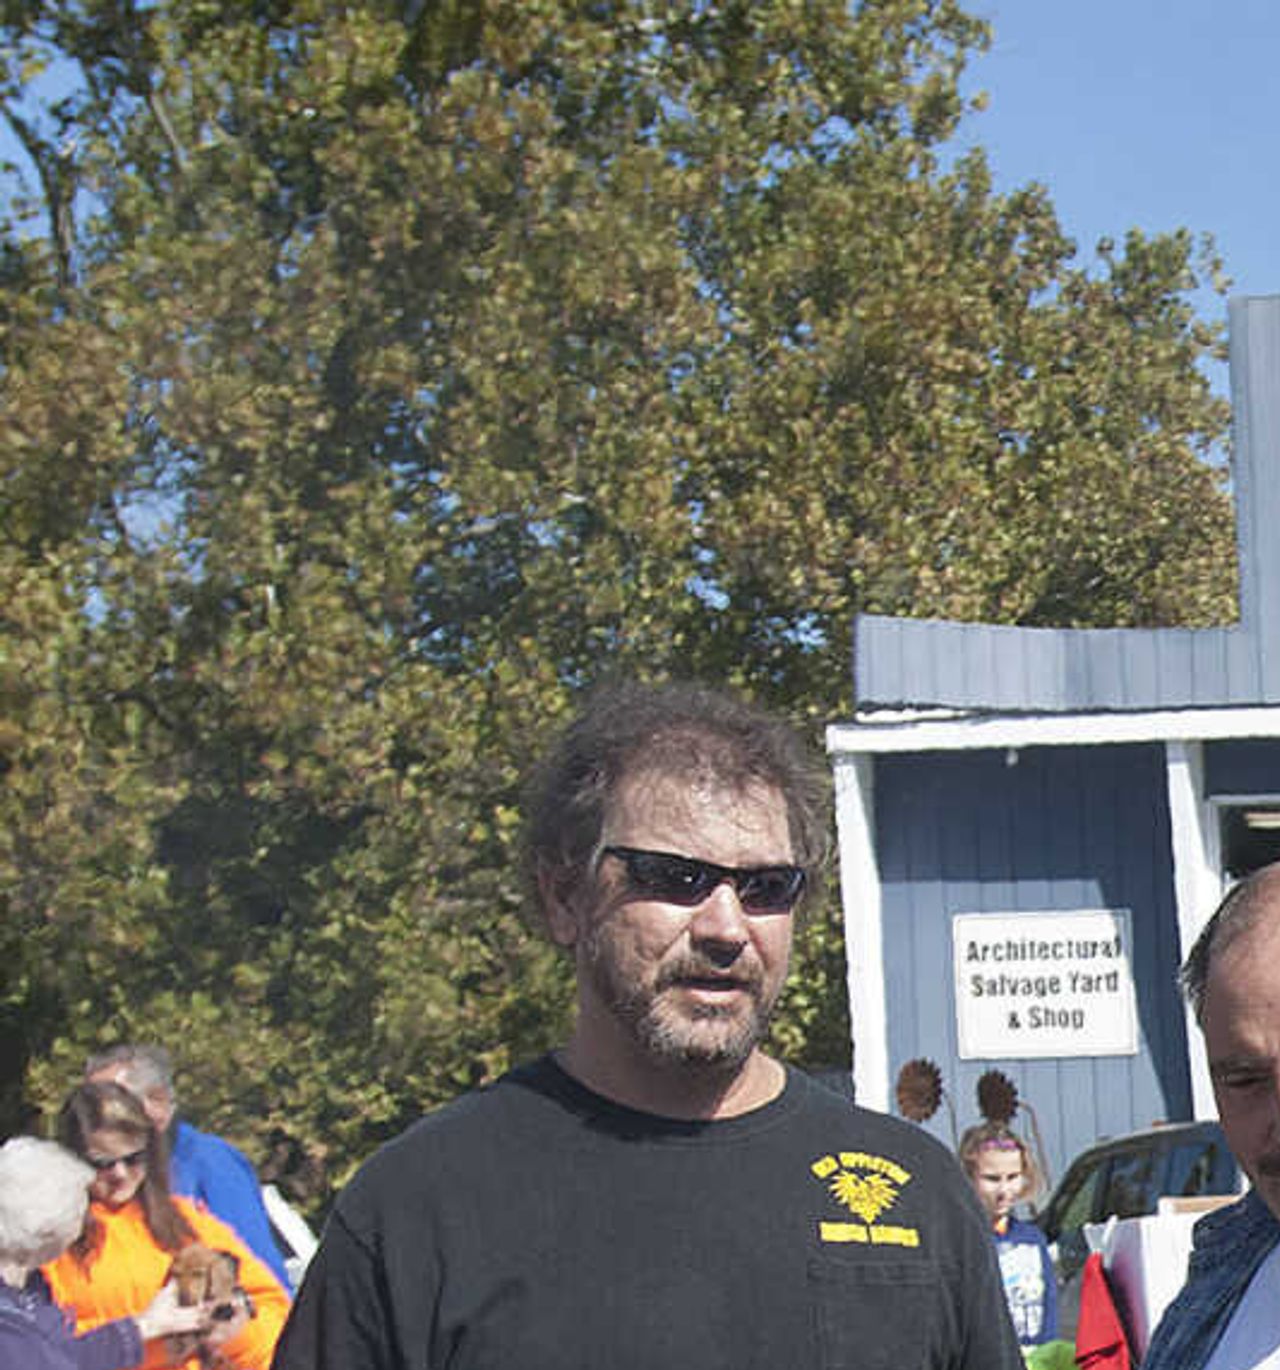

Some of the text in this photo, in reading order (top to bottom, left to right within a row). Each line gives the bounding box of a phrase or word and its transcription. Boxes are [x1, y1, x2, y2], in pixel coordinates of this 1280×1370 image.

[966, 936, 1122, 962] Architectural
[970, 969, 1119, 998] Salvage Yard
[1008, 1005, 1085, 1031] & Shop
